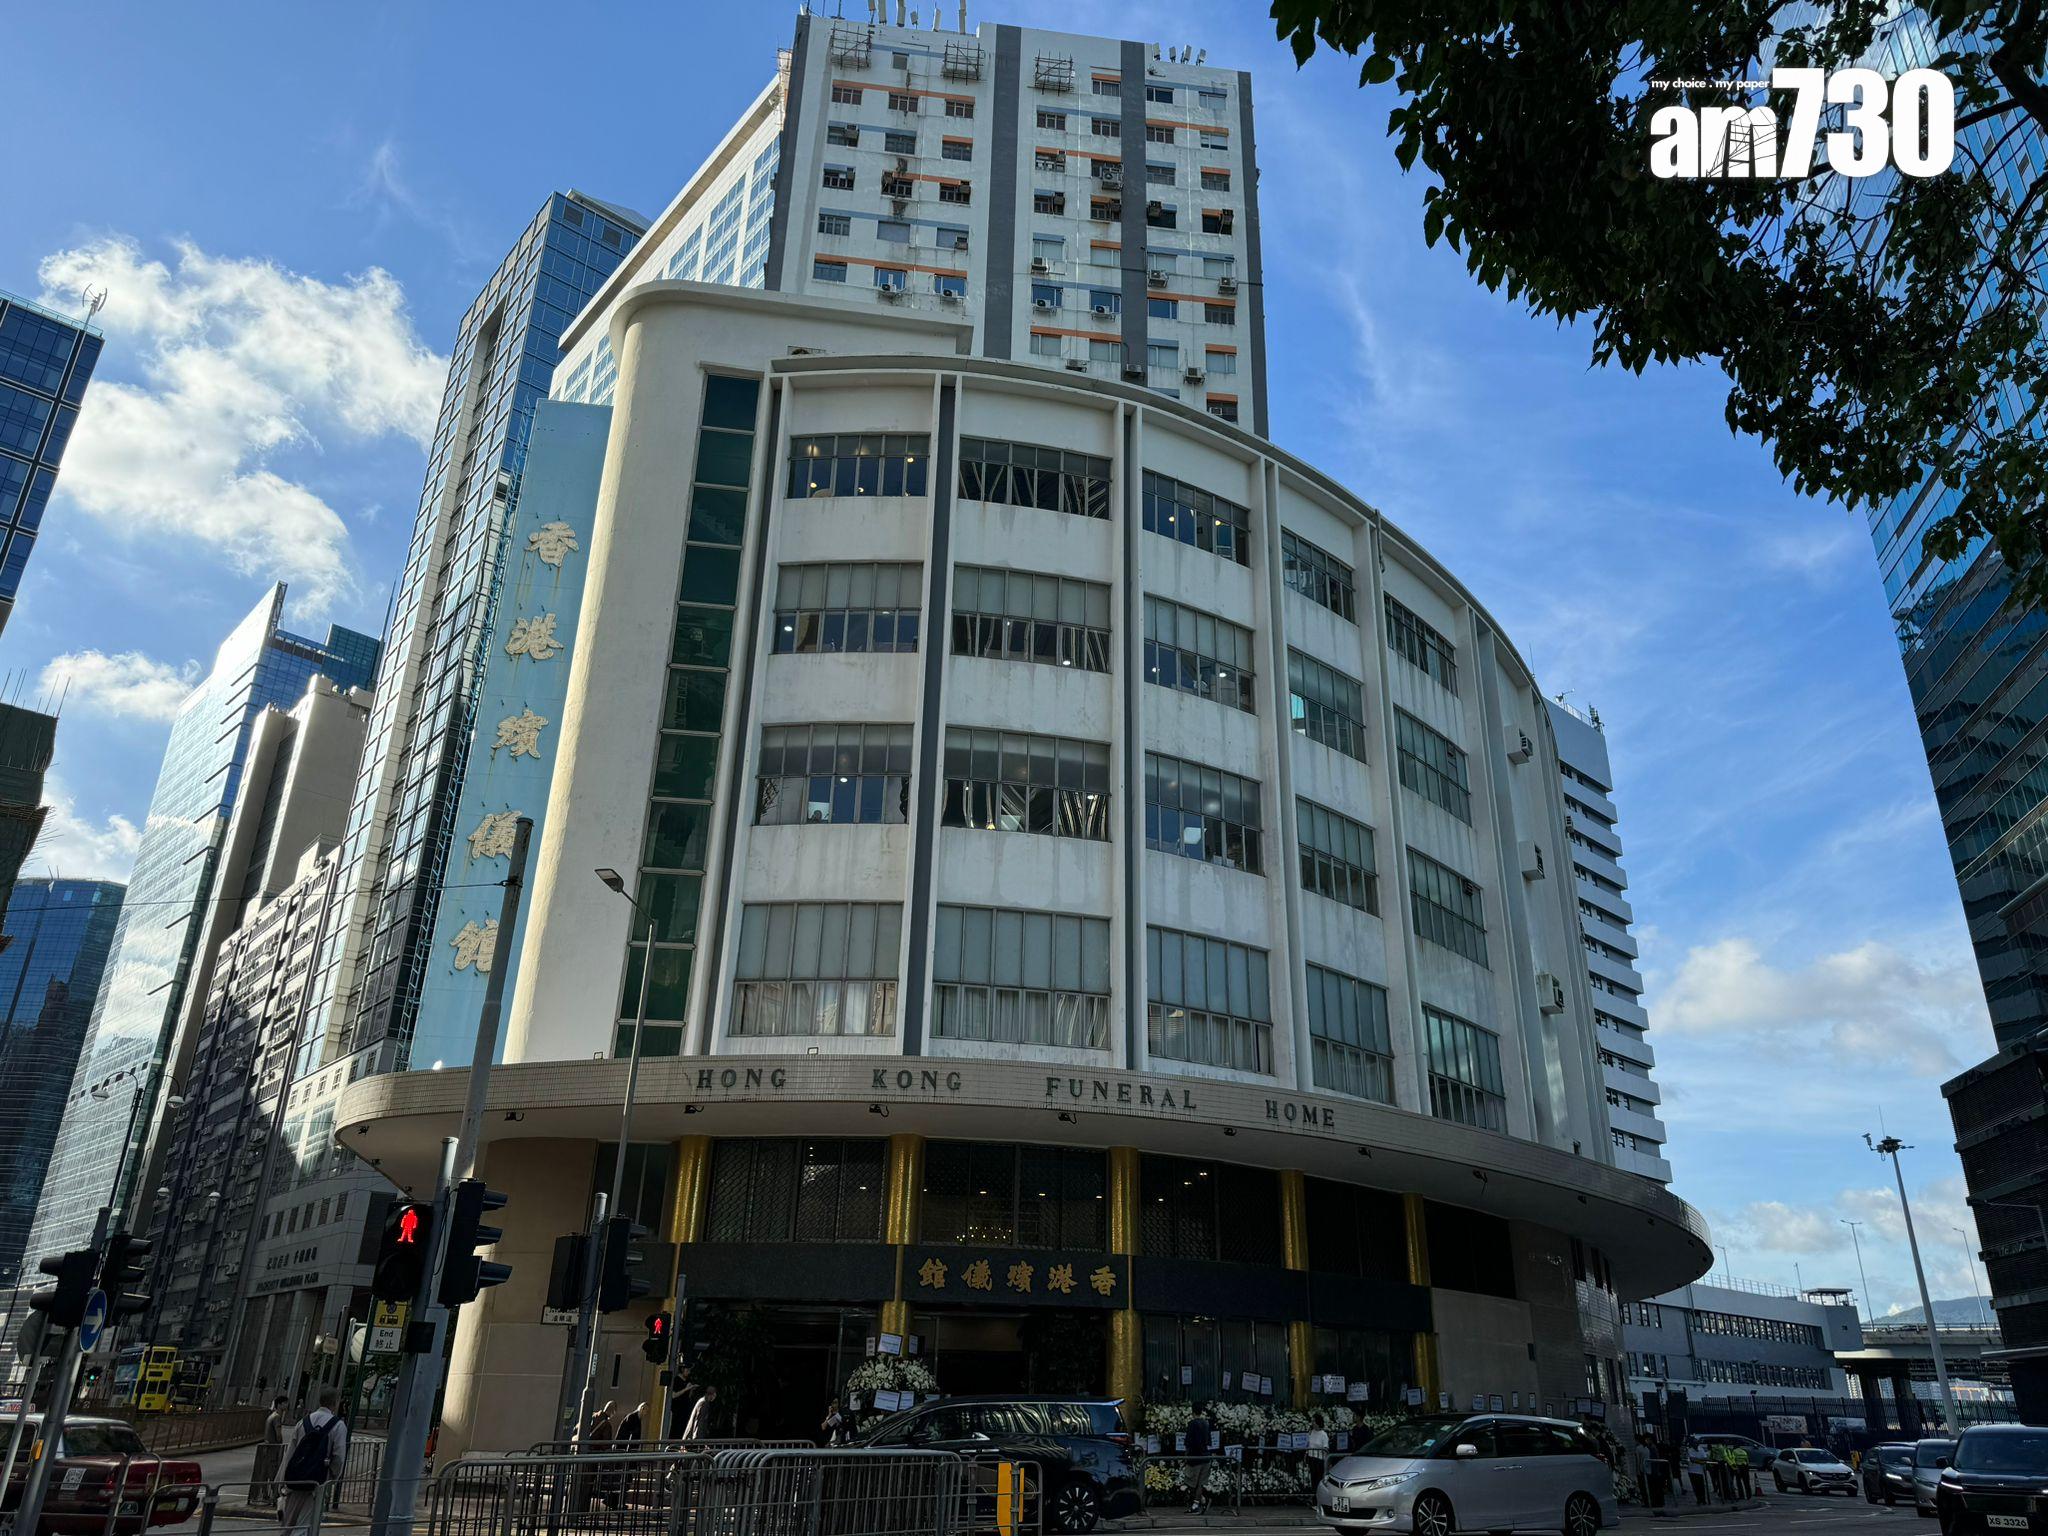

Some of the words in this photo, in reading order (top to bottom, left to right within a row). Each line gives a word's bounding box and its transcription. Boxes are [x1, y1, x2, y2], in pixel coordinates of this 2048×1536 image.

[696, 1068, 787, 1089] HONG
[871, 1068, 962, 1091] KONG
[1045, 1076, 1198, 1109] FUNERAL
[1265, 1099, 1336, 1127] HOME
[380, 1330, 394, 1338] End
[1989, 1516, 2001, 1525] XS
[2003, 1518, 2027, 1527] 3326
